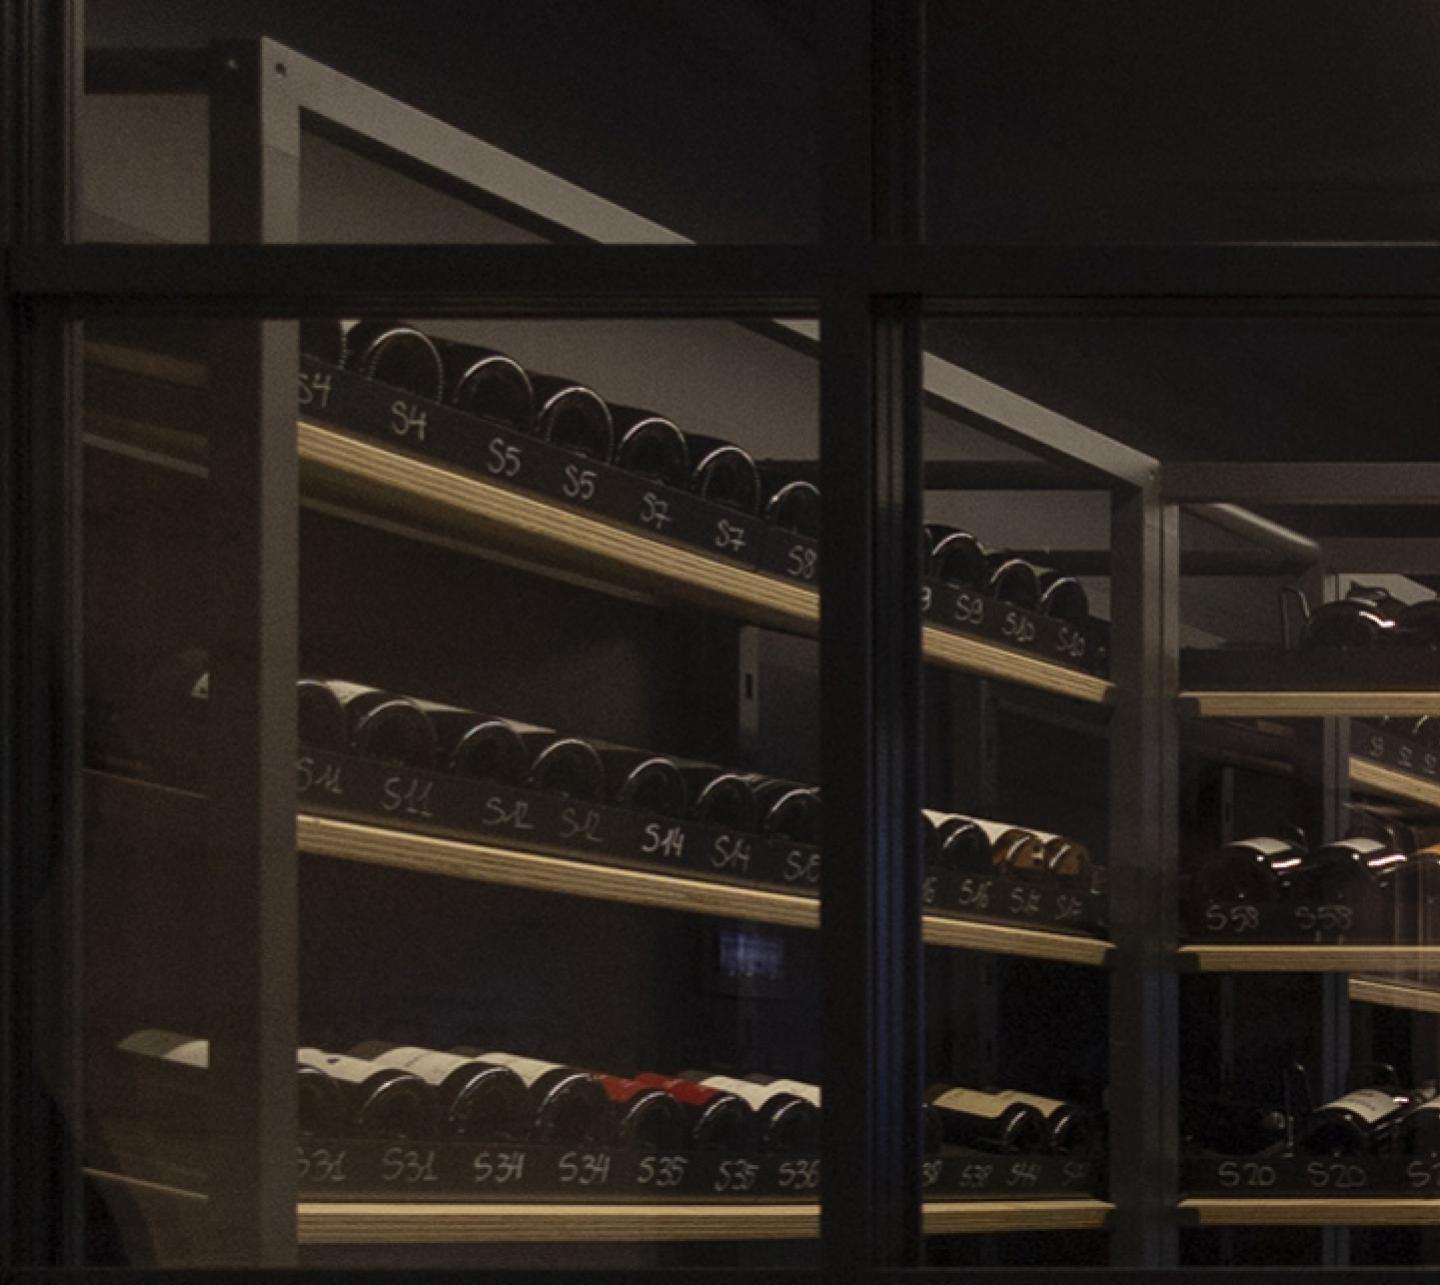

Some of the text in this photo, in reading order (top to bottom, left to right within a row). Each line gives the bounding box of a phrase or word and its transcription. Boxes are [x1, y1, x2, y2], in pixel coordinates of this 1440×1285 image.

[391, 401, 427, 441] S4
[487, 438, 522, 477] S5
[562, 464, 597, 500] S5
[713, 519, 747, 552] S7
[473, 1152, 526, 1183] S34
[558, 1150, 611, 1185] S34
[636, 1153, 689, 1187] S35
[1216, 1162, 1276, 1189] S20
[1306, 1163, 1367, 1188] S20
